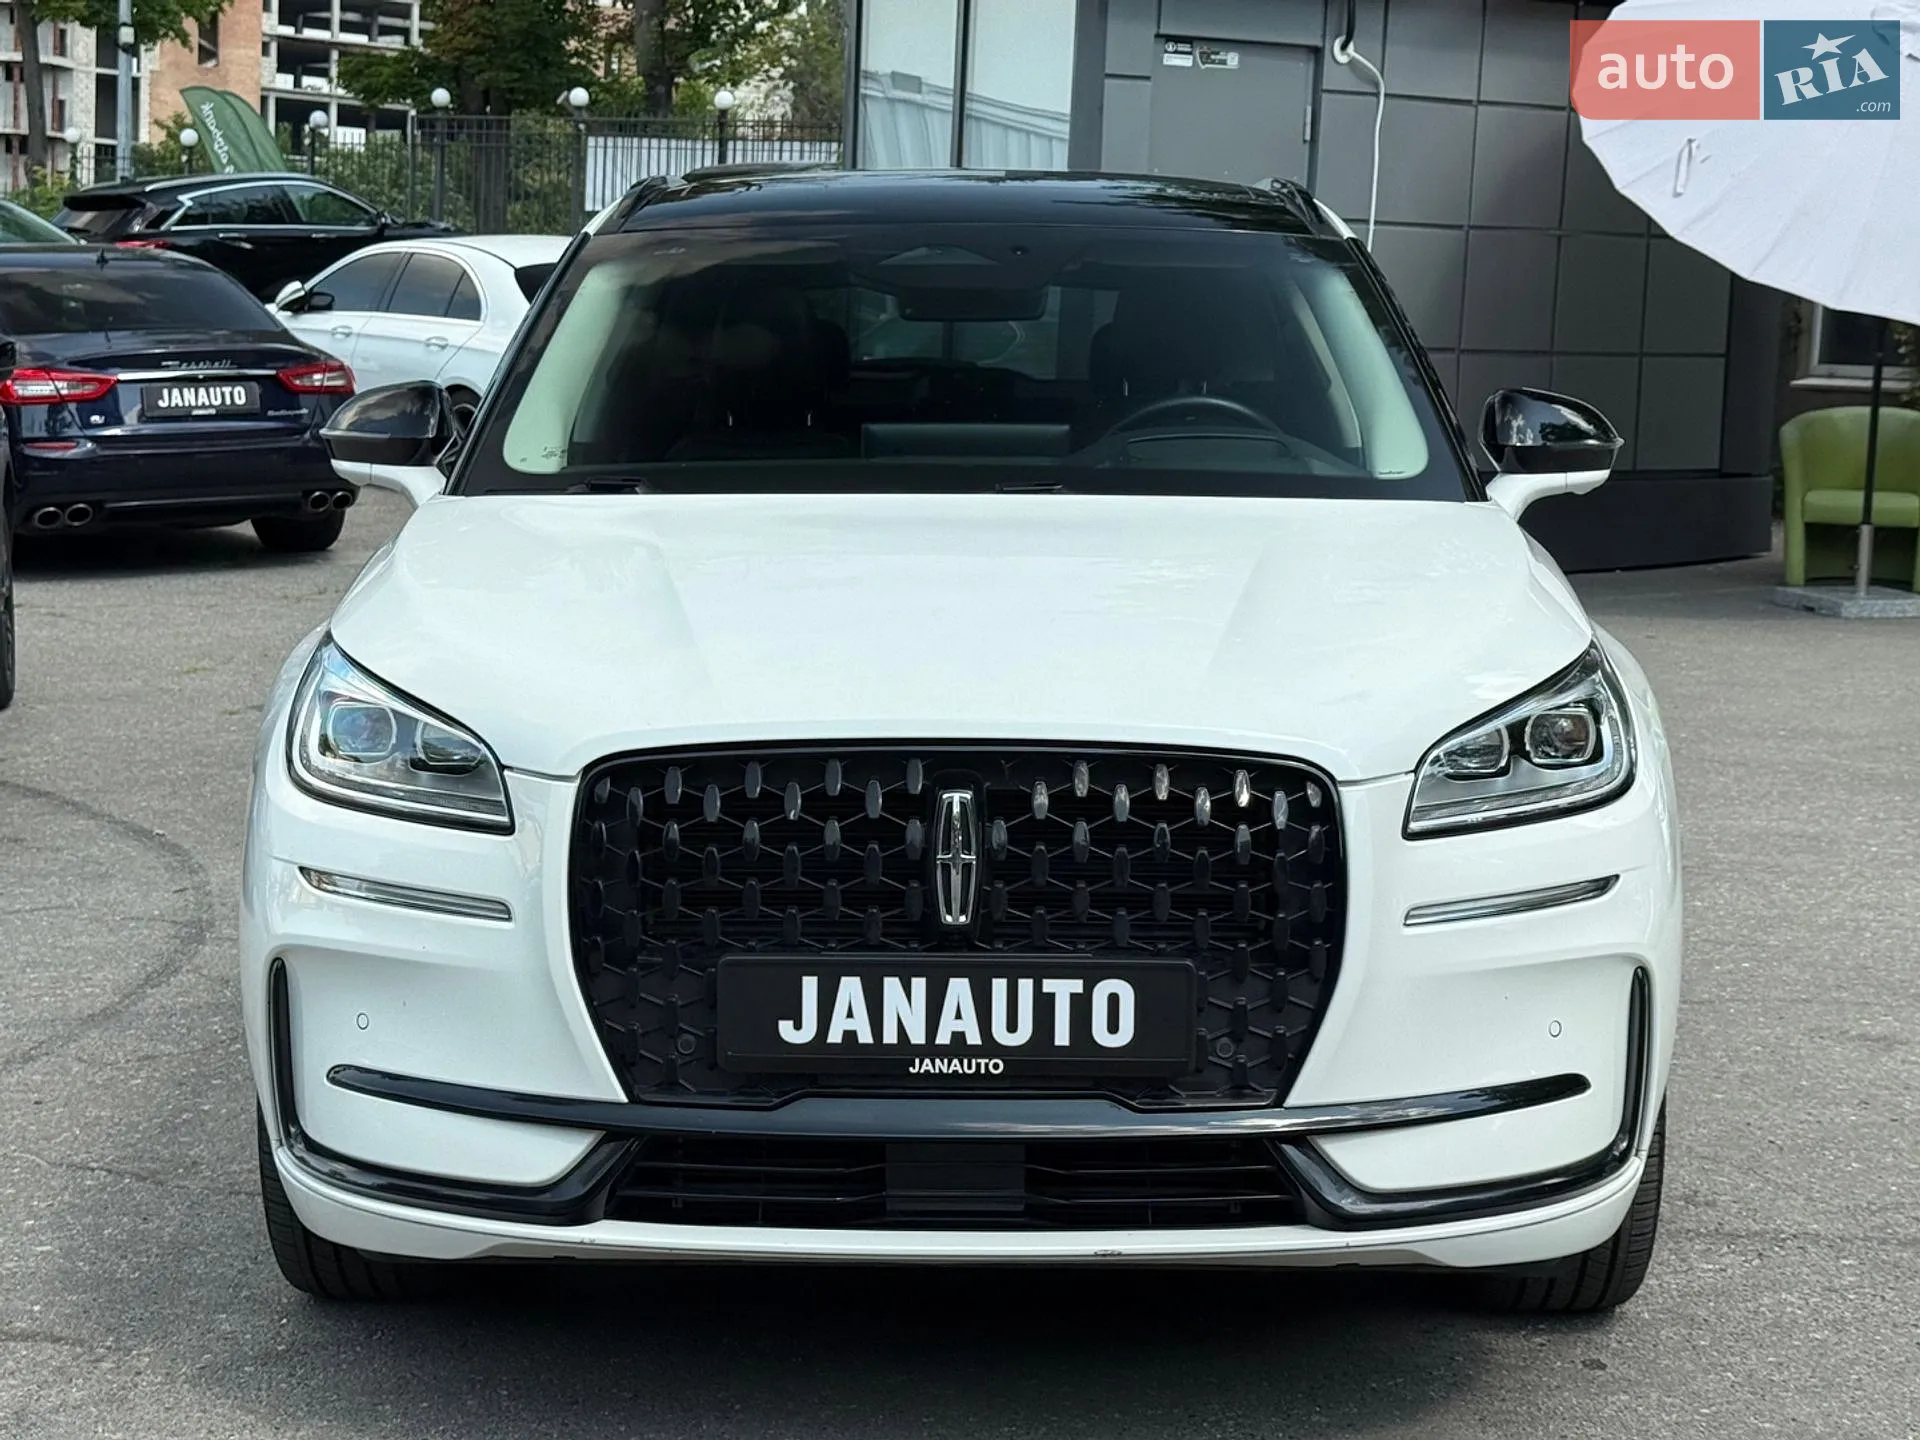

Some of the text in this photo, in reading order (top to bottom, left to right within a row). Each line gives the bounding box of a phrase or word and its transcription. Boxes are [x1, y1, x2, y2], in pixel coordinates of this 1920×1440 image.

[157, 385, 247, 408] JANAUTO
[777, 975, 1136, 1048] JANAUTO
[908, 1057, 1005, 1075] JANAUTO
